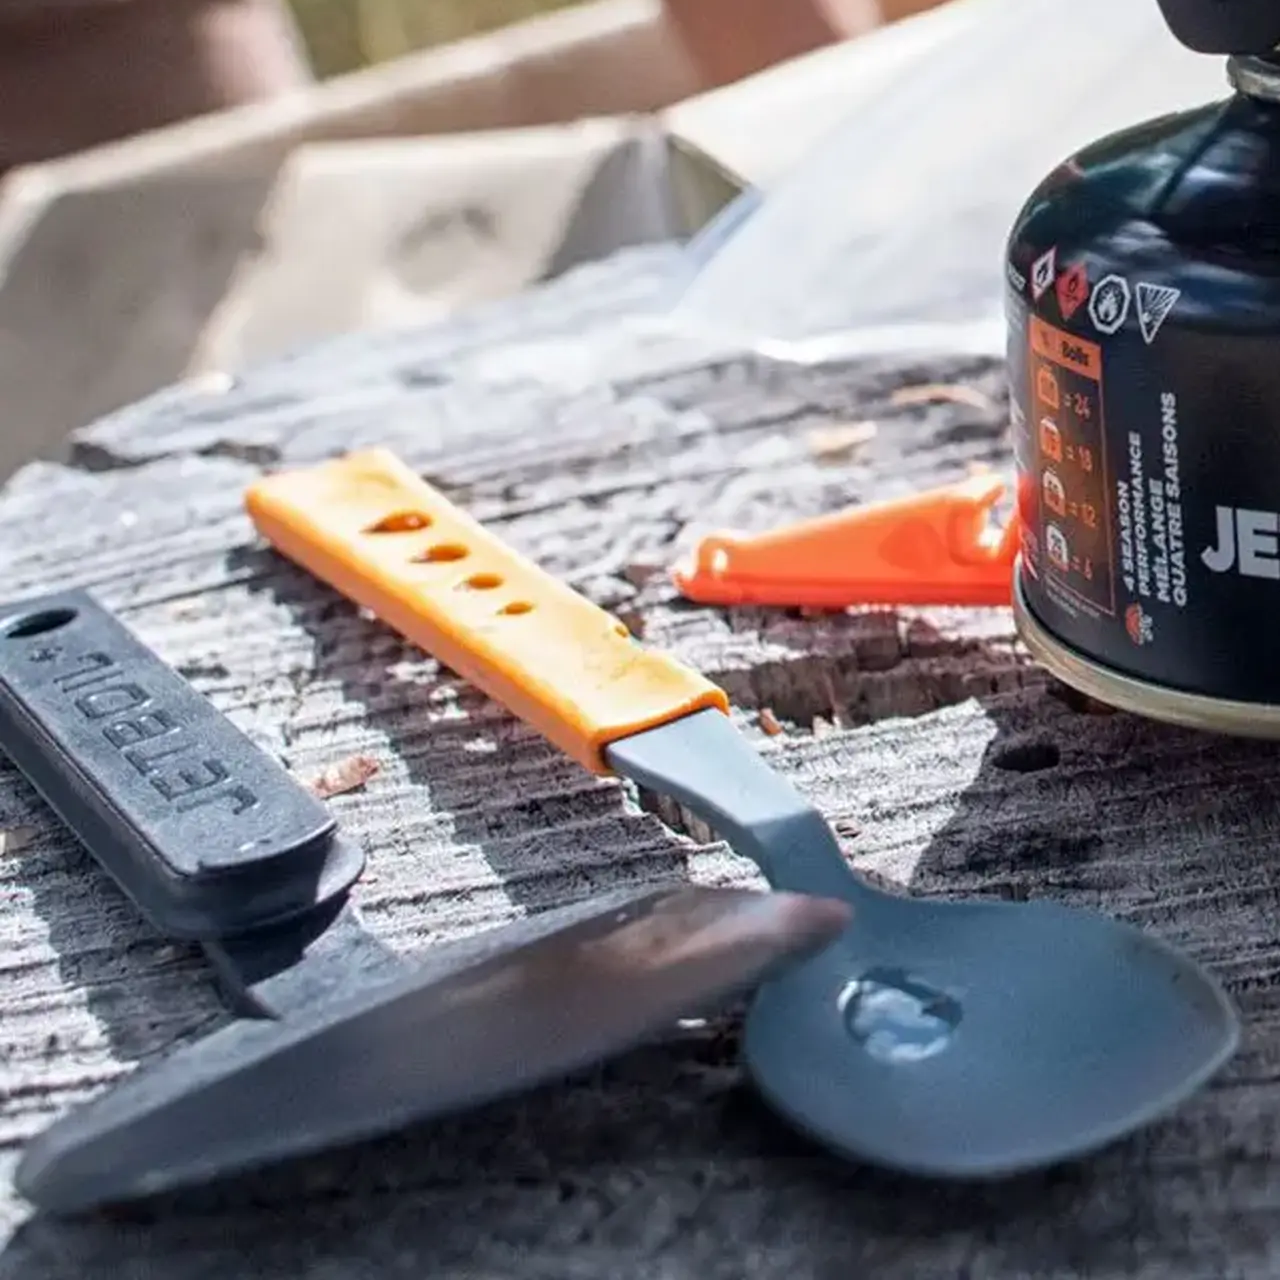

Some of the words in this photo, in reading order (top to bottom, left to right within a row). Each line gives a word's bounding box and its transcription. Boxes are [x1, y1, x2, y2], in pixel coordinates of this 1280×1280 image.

[1160, 392, 1181, 499] SAISONS
[1117, 480, 1134, 572] SEASON
[1128, 431, 1151, 597] PERFORMANCE
[1167, 502, 1187, 607] QUATRE
[1123, 576, 1135, 592] 4
[54, 650, 261, 816] JETBOIL
